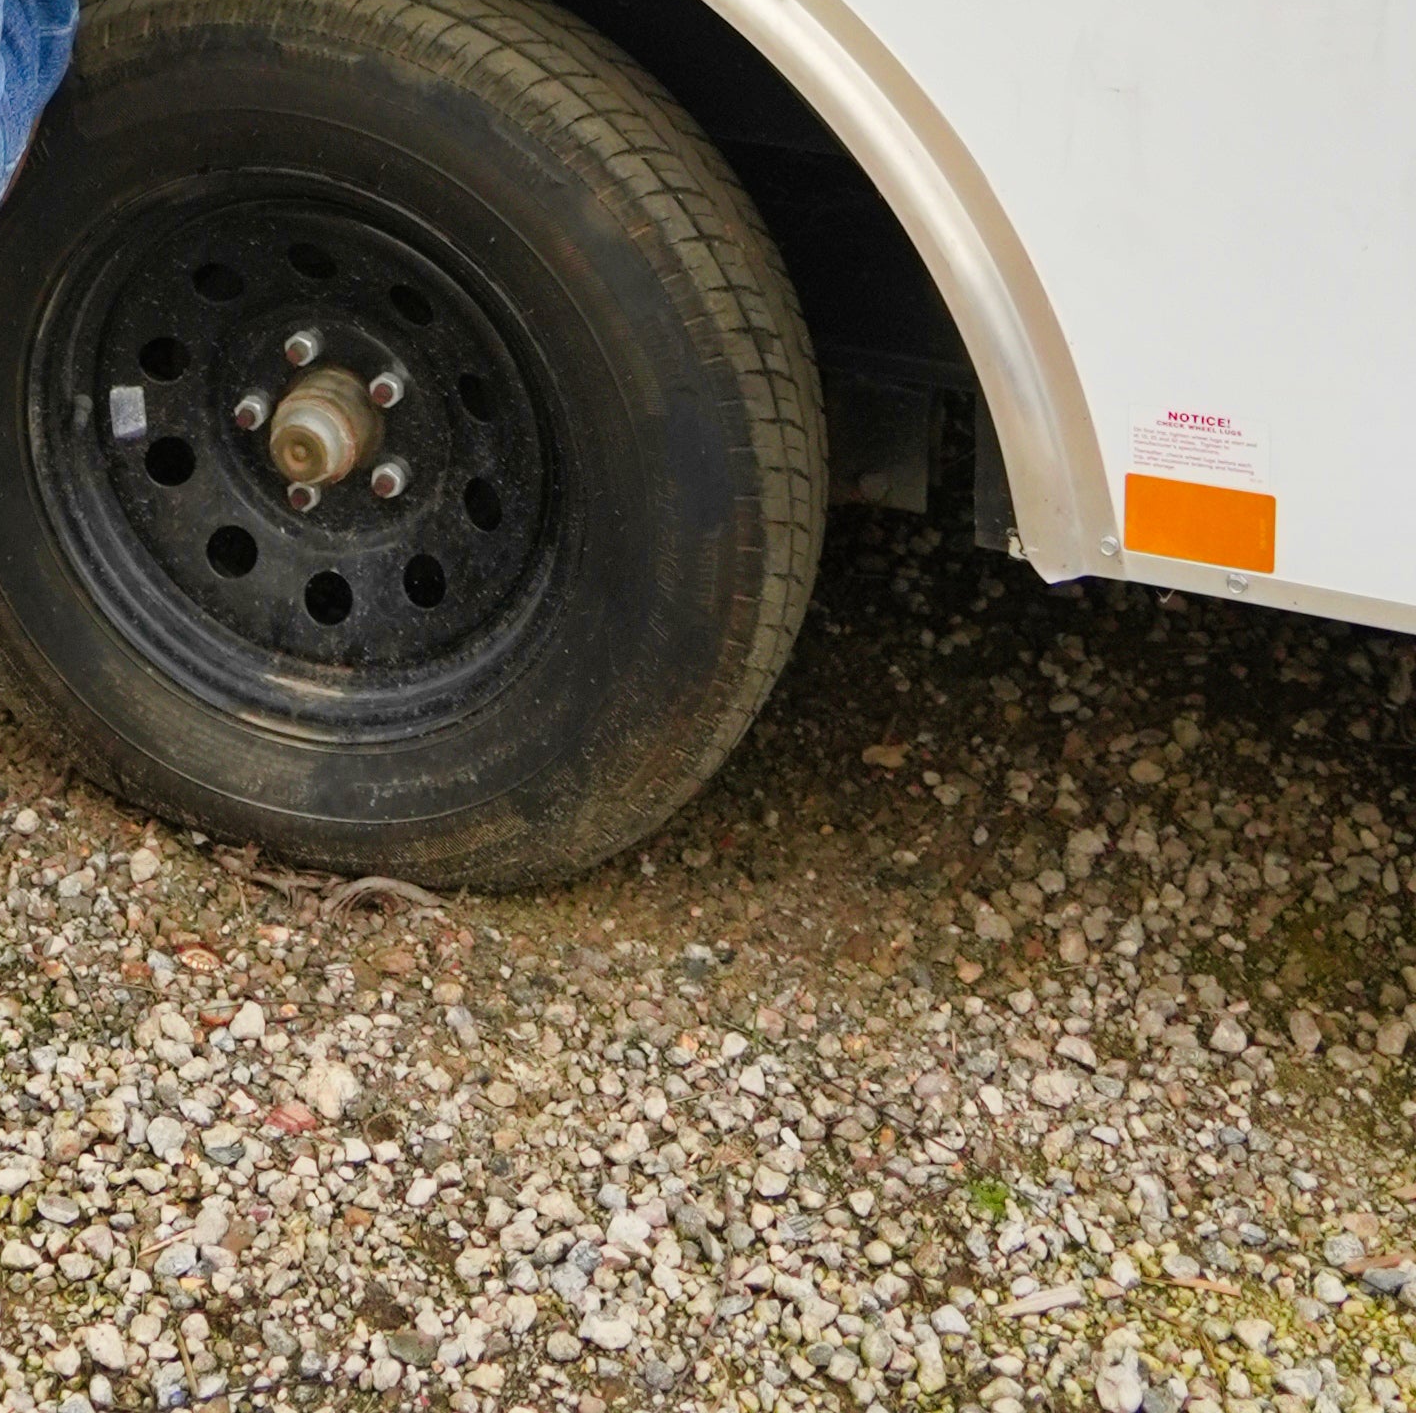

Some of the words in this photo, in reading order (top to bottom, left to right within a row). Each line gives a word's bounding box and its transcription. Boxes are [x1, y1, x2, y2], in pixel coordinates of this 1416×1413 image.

[1168, 411, 1231, 428] NOTICE!
[1188, 424, 1217, 434] WHEEL
[1219, 428, 1242, 436] LUGS
